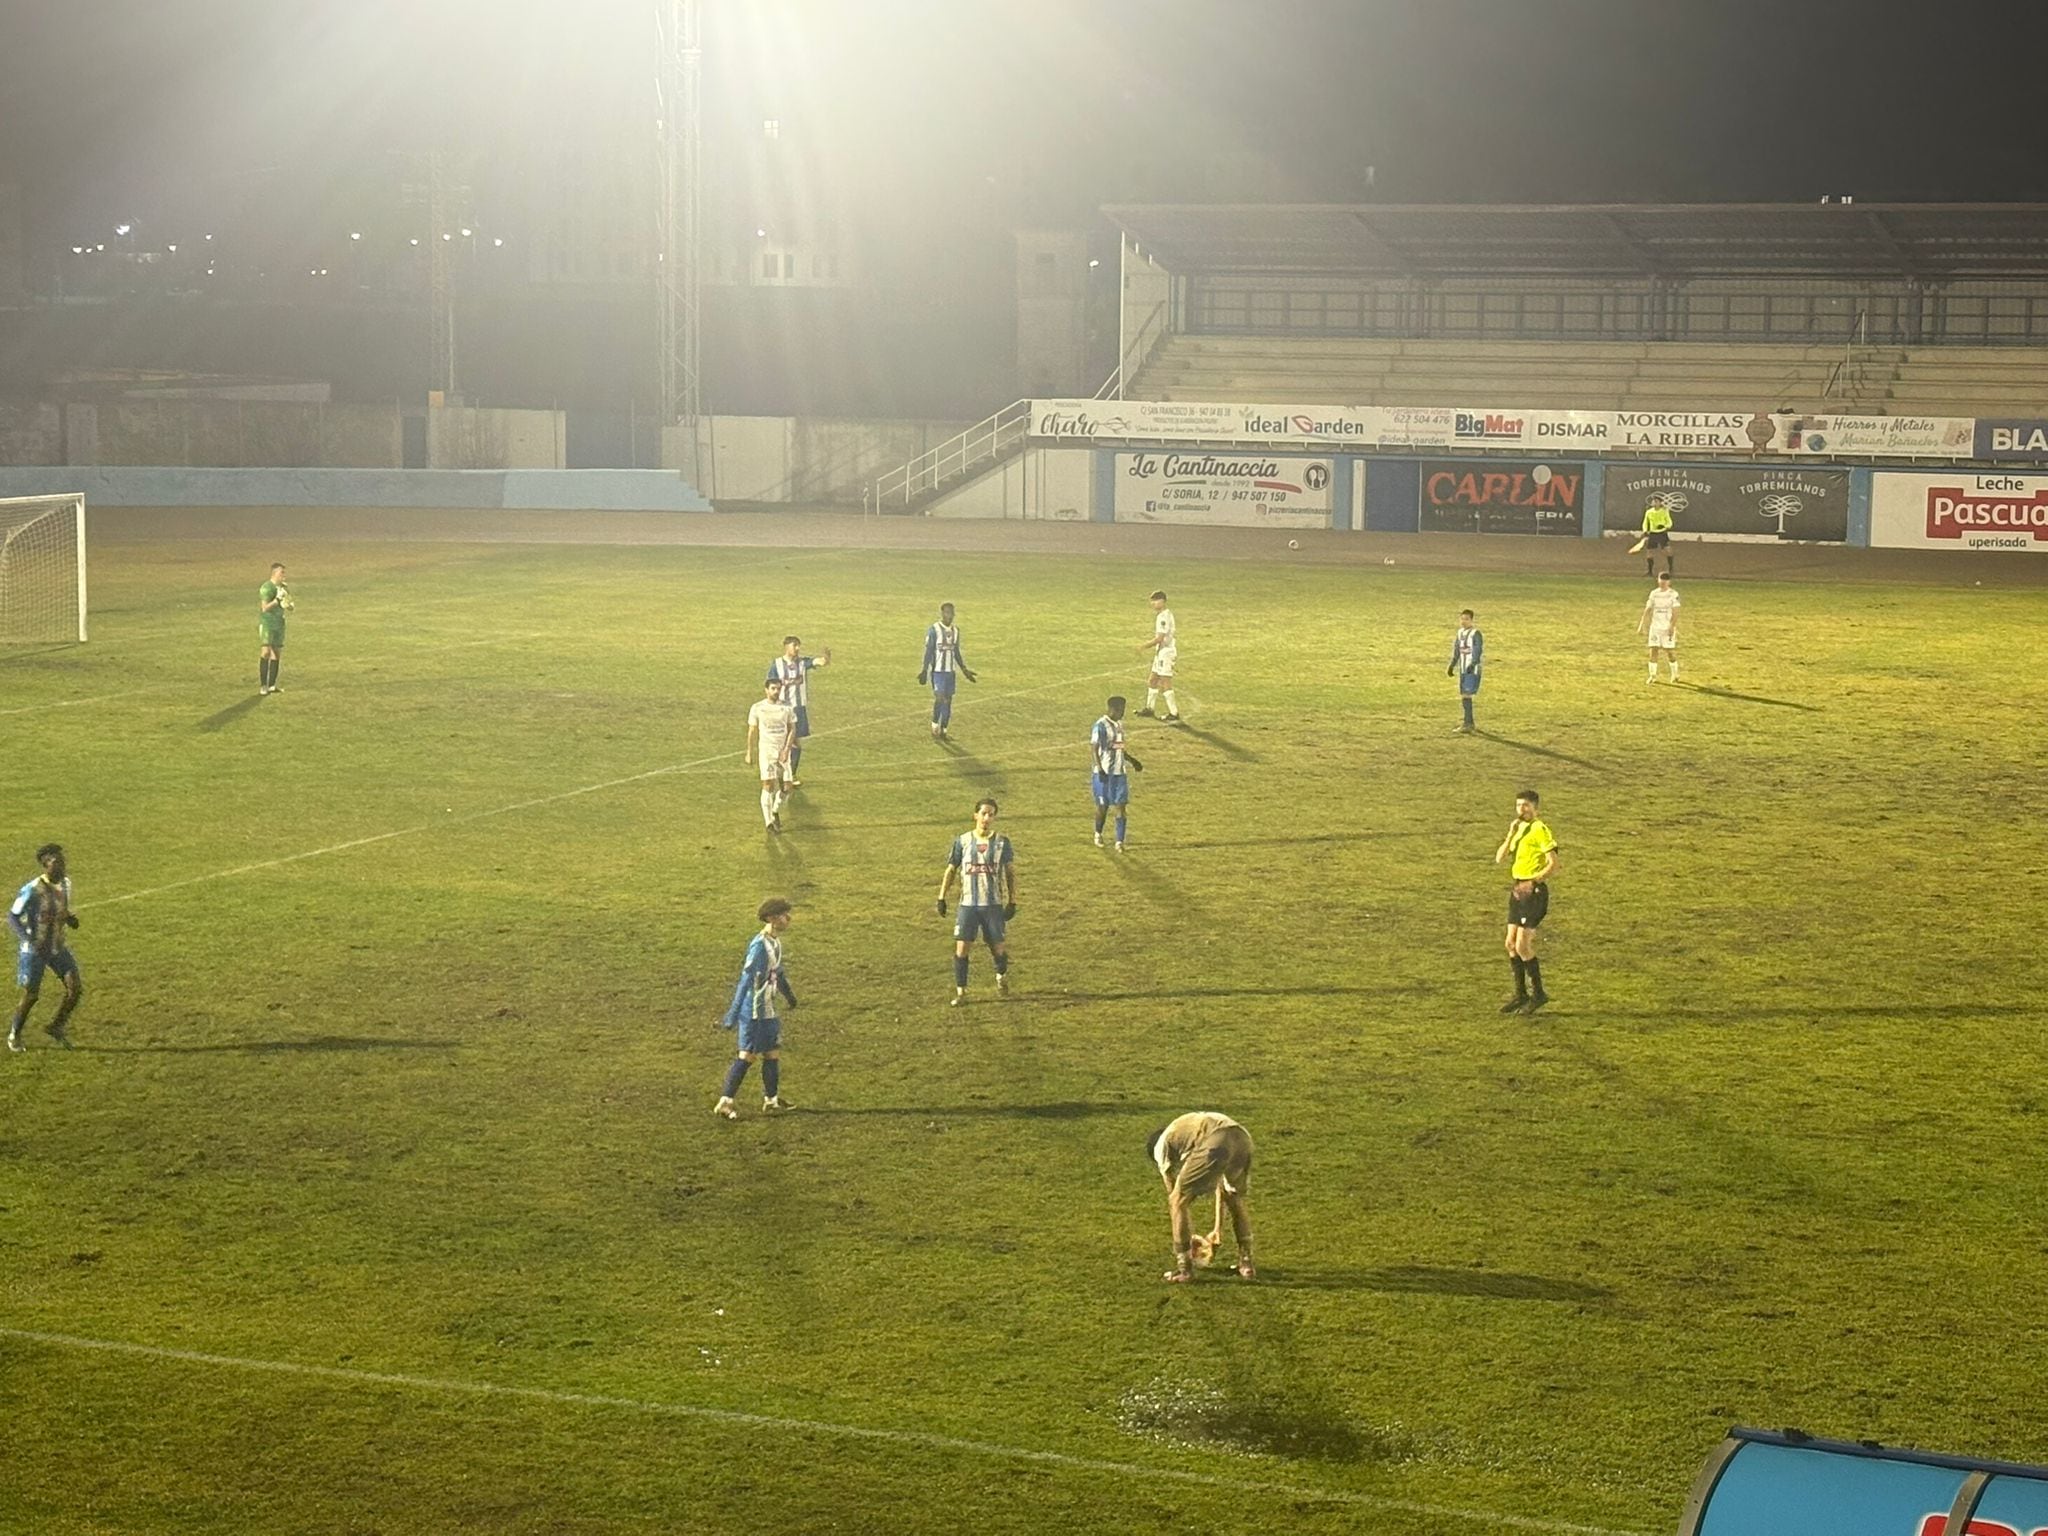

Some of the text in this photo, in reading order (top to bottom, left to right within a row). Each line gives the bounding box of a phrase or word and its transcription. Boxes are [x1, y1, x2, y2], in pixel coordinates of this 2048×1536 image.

[1040, 412, 1098, 435] Charo
[1245, 415, 1288, 433] ideal
[1394, 415, 1450, 425] 622 504 476
[1455, 414, 1524, 437] BigMat
[1616, 413, 1744, 428] MORCILLAS
[1833, 417, 1935, 435] Hierros y Metales
[1538, 423, 1607, 437] DISMAR
[1626, 432, 1737, 446] LA RIBERA
[1992, 427, 2048, 452] BLA
[1129, 454, 1280, 479] La Cantinaccia
[1649, 469, 1688, 478] FINCA
[1763, 472, 1801, 481] FINCA
[1976, 476, 2024, 491] Leche
[1627, 478, 1712, 494] TORREMILANOS
[1739, 481, 1827, 497] TORREMILANOS
[1162, 488, 1287, 503] C/ SORIA, 12 / 947 507 150
[1935, 497, 2048, 526] Pascua
[1969, 537, 2027, 549] uperisada
